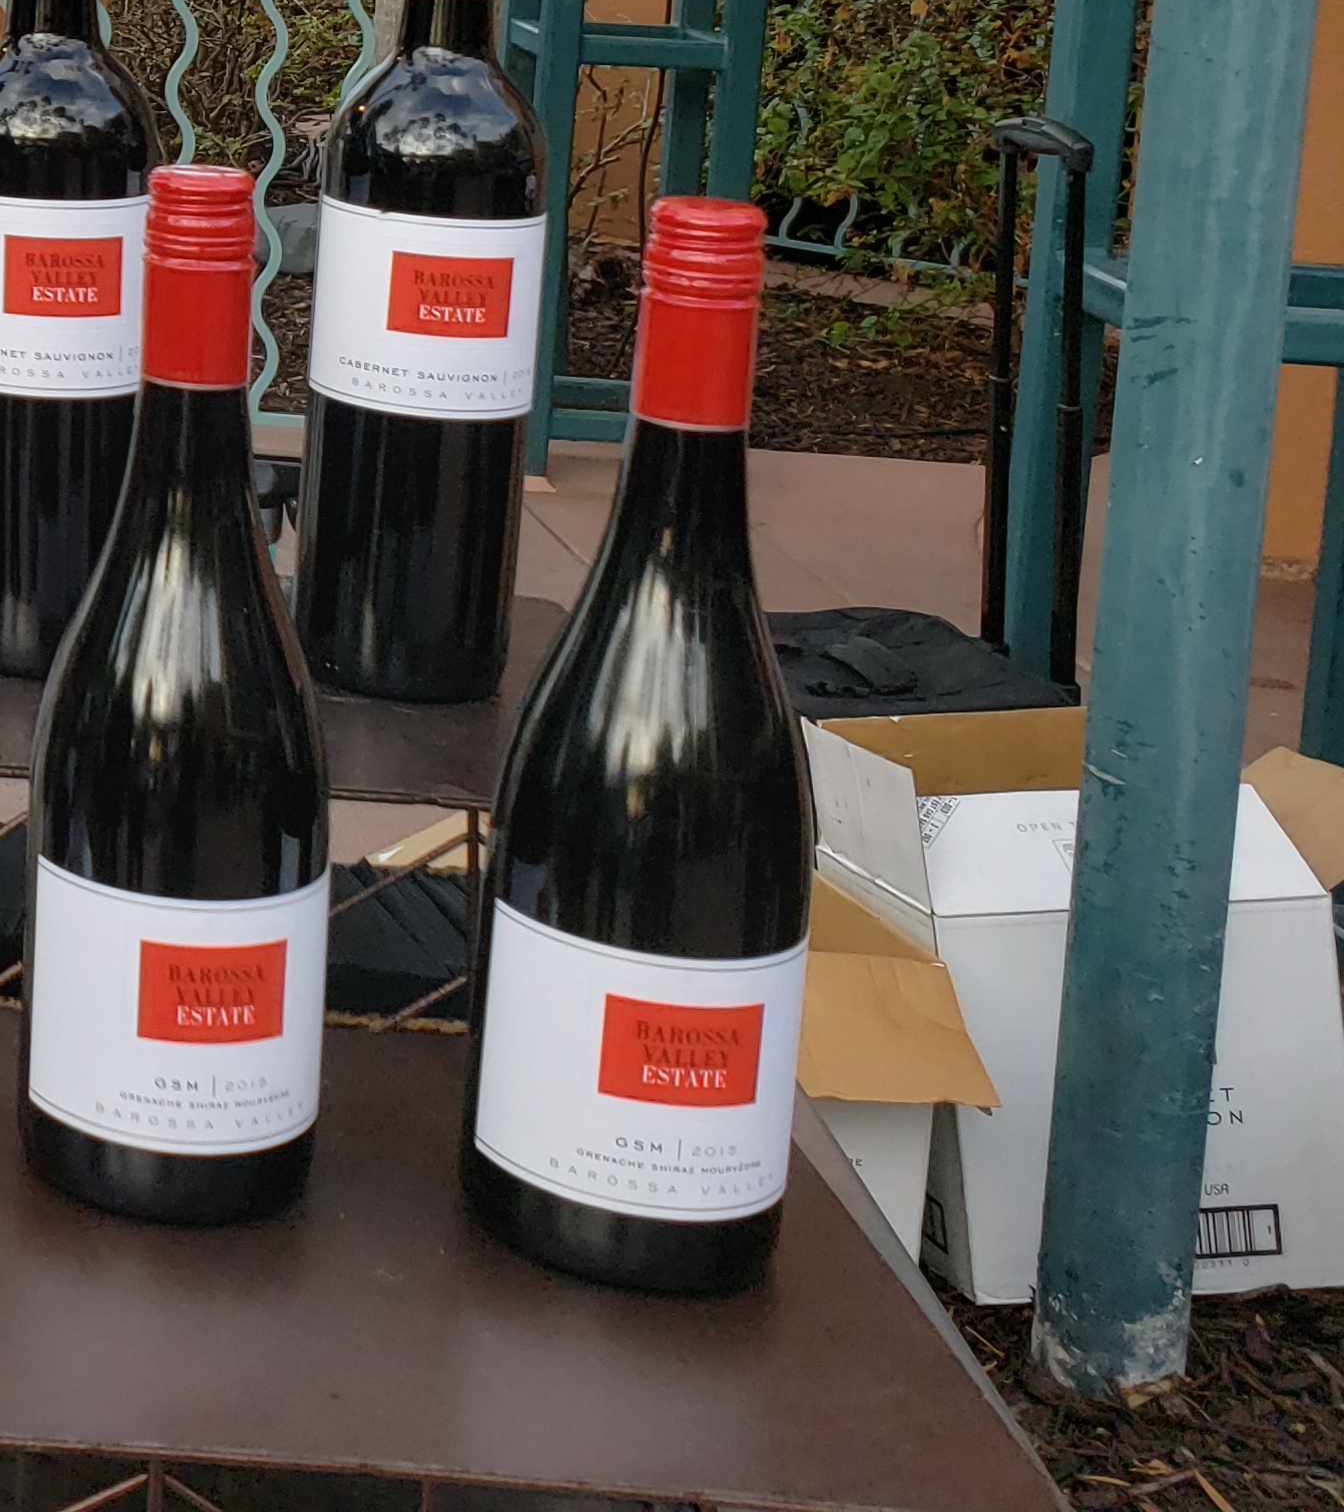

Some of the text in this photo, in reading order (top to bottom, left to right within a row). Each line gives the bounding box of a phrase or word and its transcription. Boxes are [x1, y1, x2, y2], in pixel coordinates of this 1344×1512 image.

[25, 252, 105, 268] BAROSSA
[31, 270, 97, 285] VALLEY
[414, 270, 494, 290] BAROSSA
[32, 286, 98, 303] ESTATE
[419, 288, 487, 307] VALLEY
[419, 304, 486, 323] ESTATE
[34, 351, 113, 362] SAUVIGNON
[339, 356, 409, 378] CABERNET
[417, 371, 498, 383] SAUVIGNON
[351, 377, 447, 400] BAROSSA
[1017, 822, 1062, 833] OPEN
[169, 964, 265, 985] BAROSSA
[177, 986, 255, 1005] VALLEY
[177, 1004, 255, 1026] ESTATE
[636, 1020, 740, 1047] BAROSSA
[643, 1044, 729, 1068] VALLEY
[642, 1064, 727, 1089] ESTATE
[96, 1101, 214, 1130] BAROSSA
[615, 1137, 663, 1154] GSM
[576, 1147, 645, 1169] GRENACHE
[549, 1157, 678, 1194] BAROSSA
[1204, 1183, 1230, 1196] USA
